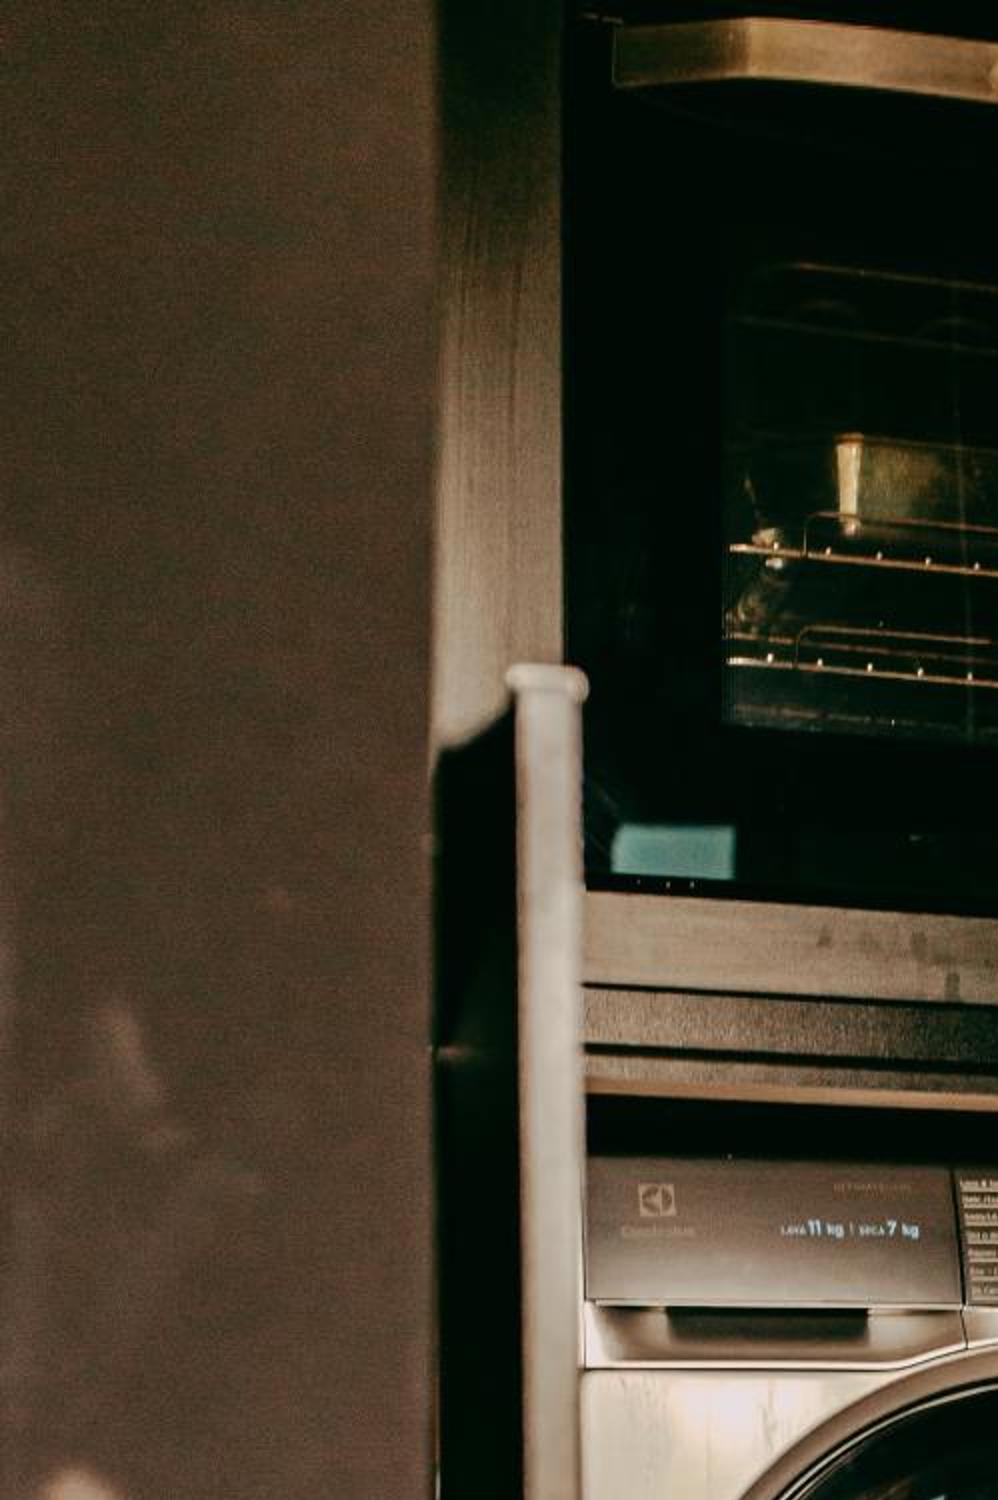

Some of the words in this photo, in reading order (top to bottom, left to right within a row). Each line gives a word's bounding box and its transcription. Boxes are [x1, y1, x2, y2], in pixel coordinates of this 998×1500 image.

[808, 1218, 822, 1237] 11
[826, 1221, 845, 1240] kg
[886, 1219, 898, 1237] 7
[902, 1222, 919, 1240] kg
